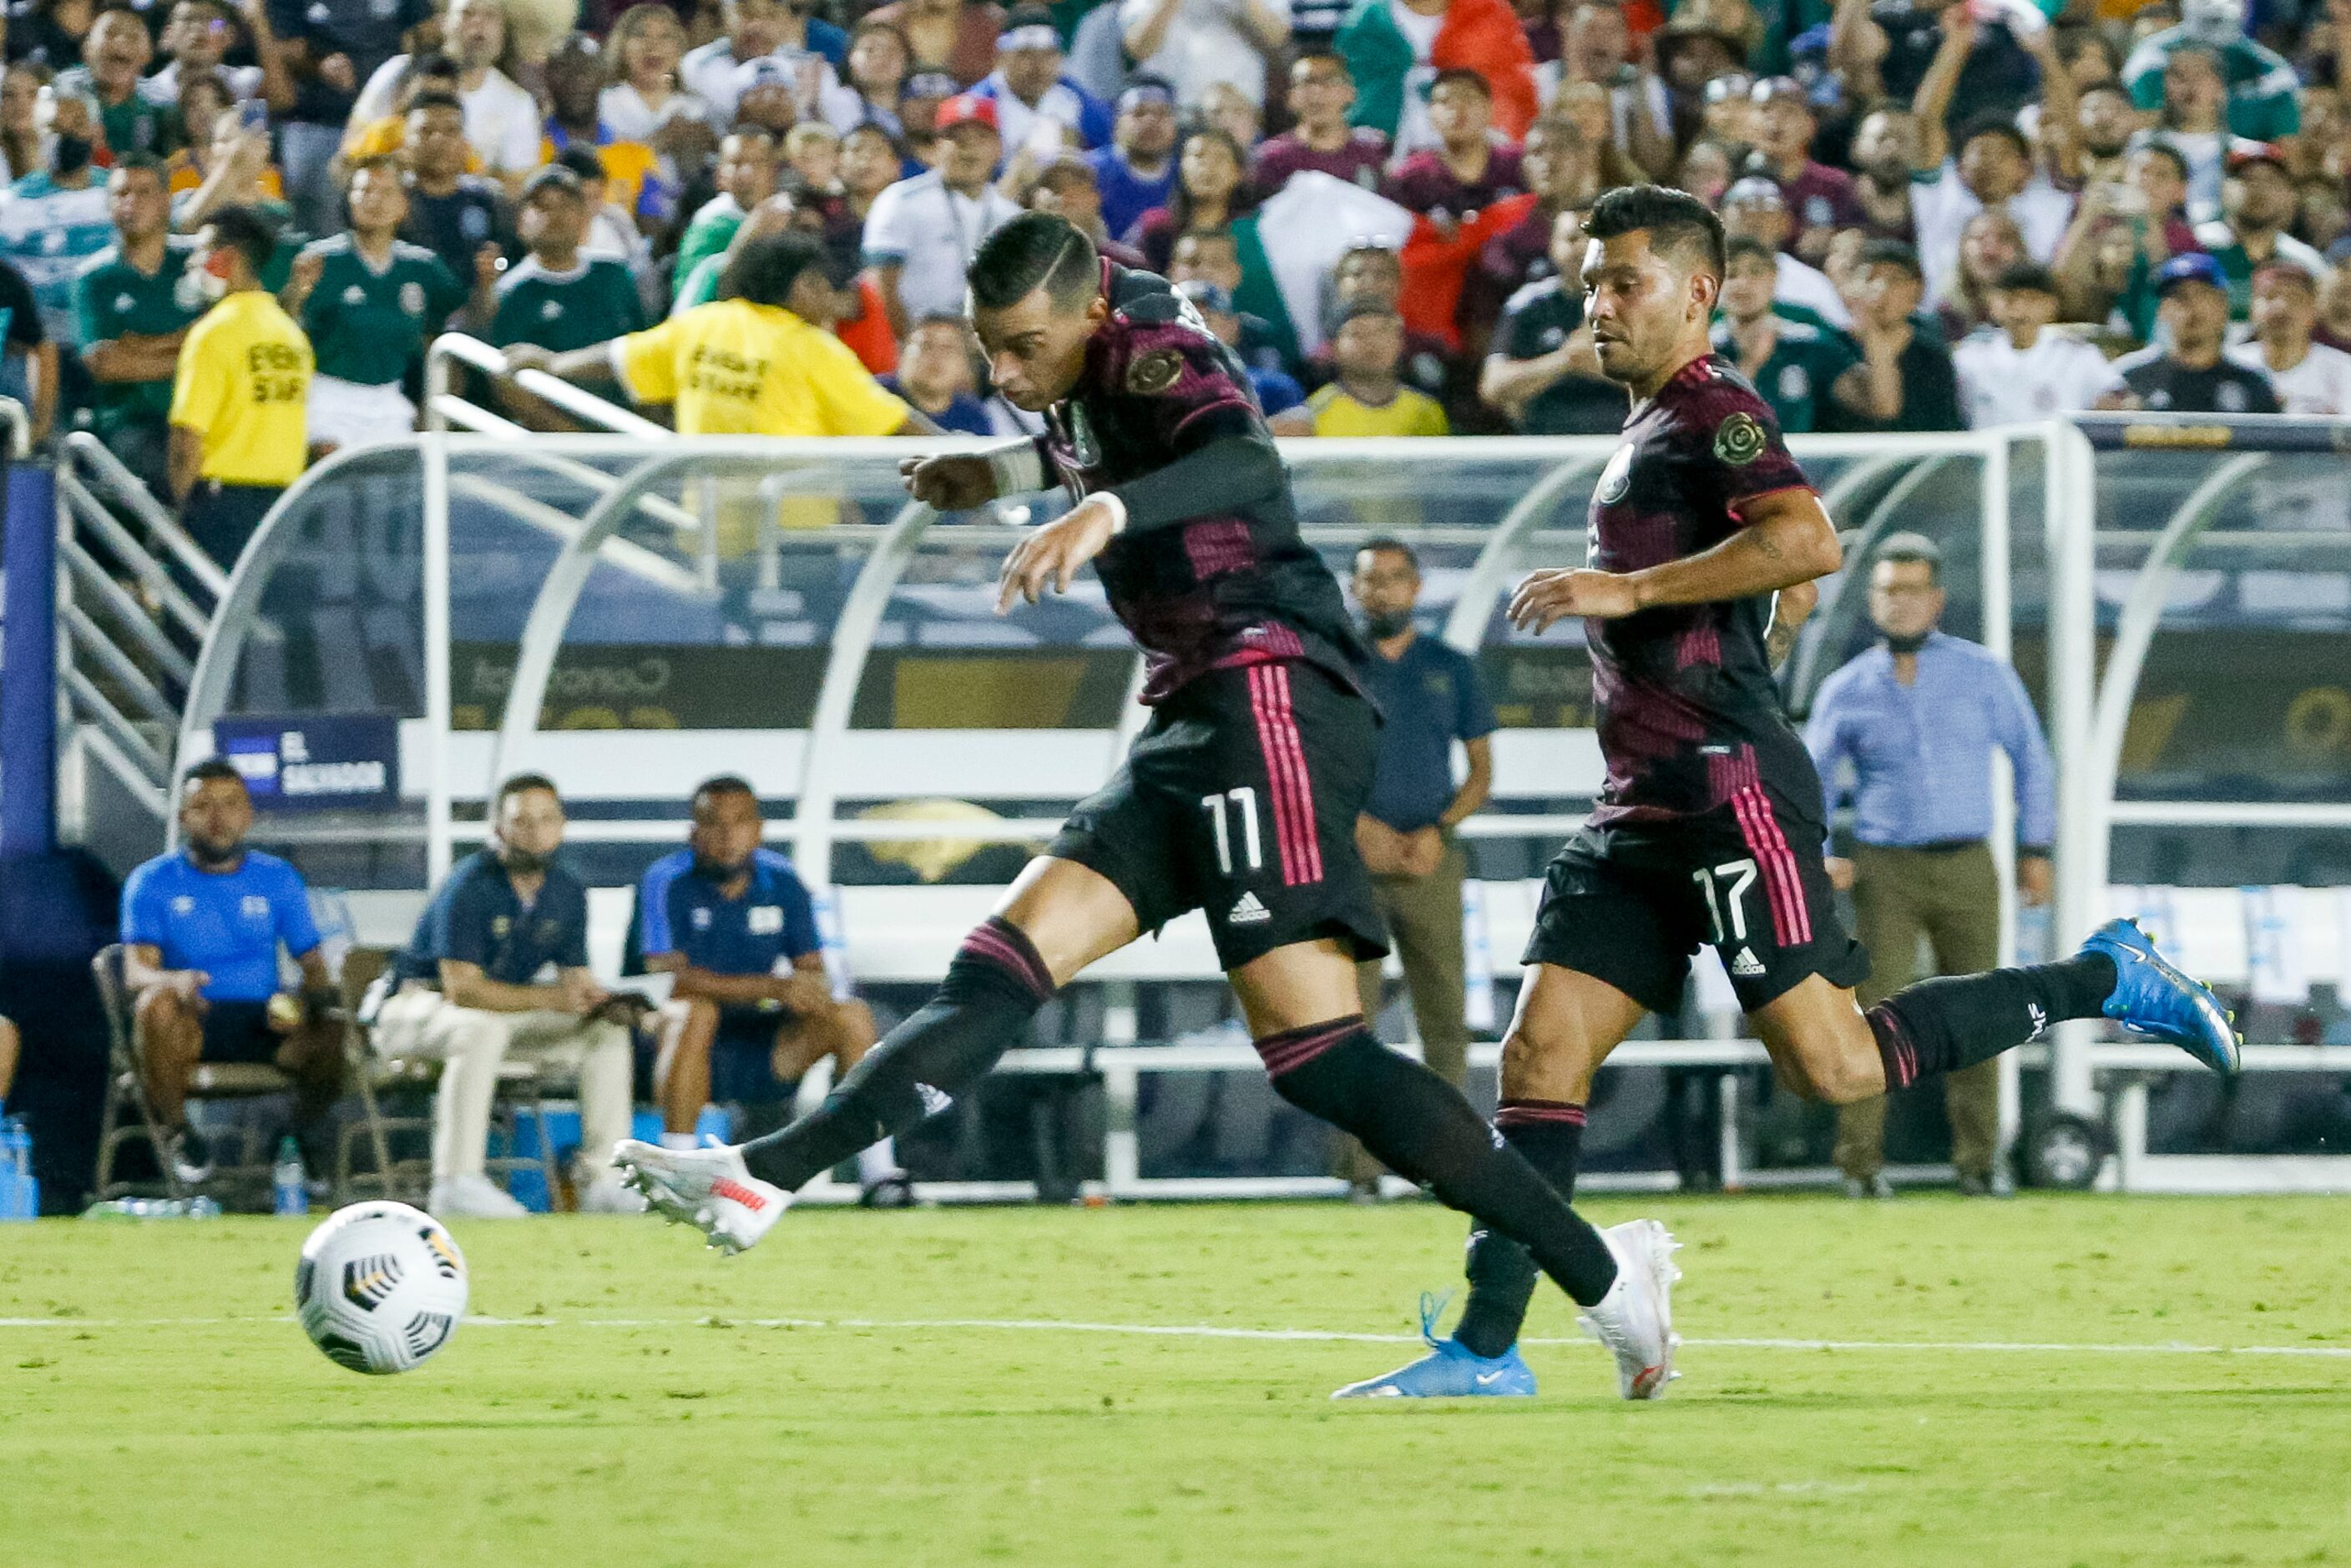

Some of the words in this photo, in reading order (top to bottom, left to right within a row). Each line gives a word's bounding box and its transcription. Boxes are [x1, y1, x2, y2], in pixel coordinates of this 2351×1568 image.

[281, 731, 308, 761] EL
[1201, 787, 1262, 873] 11
[1692, 857, 1757, 943] 17
[1229, 909, 1271, 923] adidas
[1732, 964, 1767, 975] adidas
